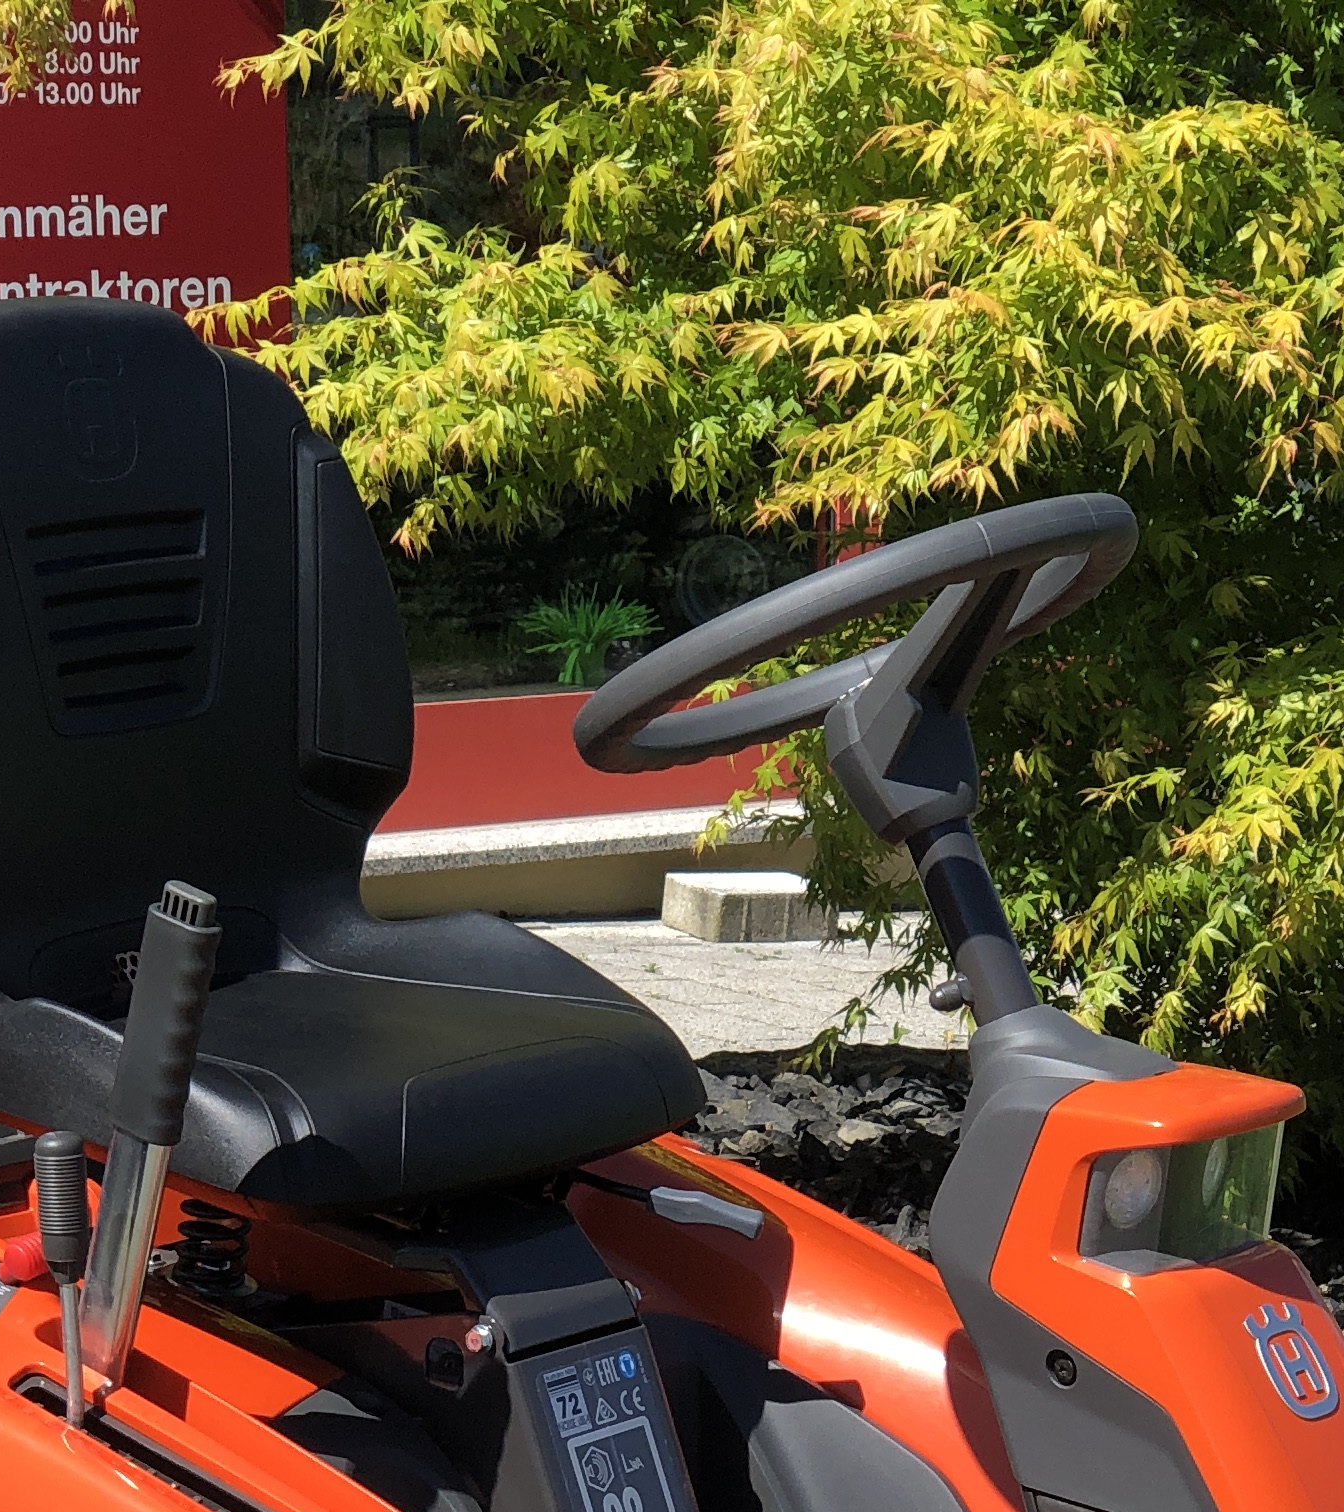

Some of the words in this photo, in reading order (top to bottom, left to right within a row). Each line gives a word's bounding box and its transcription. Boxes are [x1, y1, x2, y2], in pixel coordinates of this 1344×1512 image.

[99, 21, 140, 44] Uhr
[99, 51, 141, 74] Uhr
[34, 82, 94, 105] 13.00
[100, 82, 142, 105] Uhr
[556, 1392, 583, 1419] 72
[620, 1386, 646, 1415] CE
